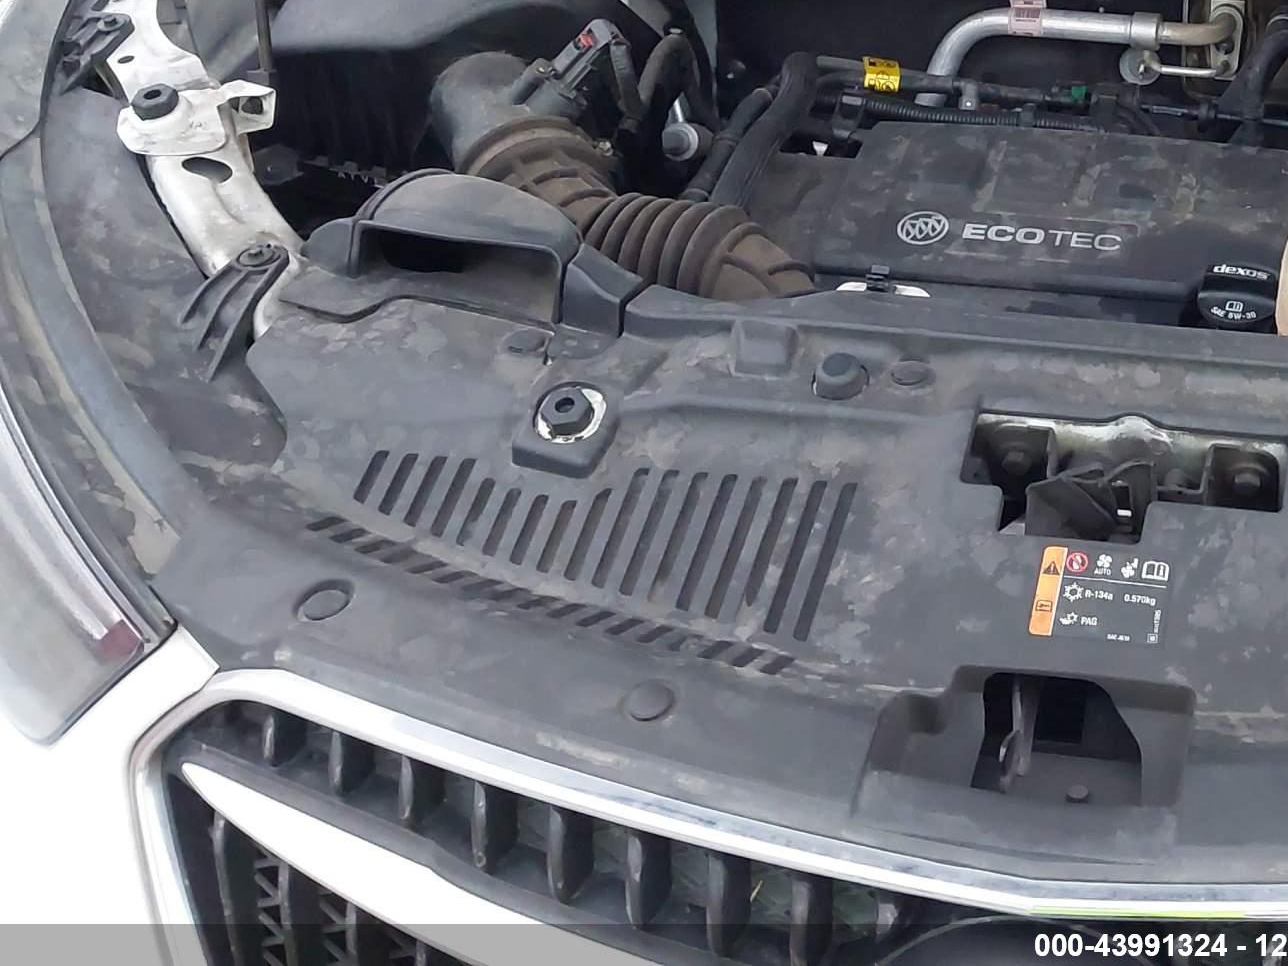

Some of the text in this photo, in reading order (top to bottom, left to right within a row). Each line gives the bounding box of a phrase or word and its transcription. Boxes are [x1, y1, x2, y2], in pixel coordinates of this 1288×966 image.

[962, 222, 1122, 251] ECOTEC
[1212, 263, 1269, 280] dexos
[1093, 567, 1112, 576] AUTO
[1084, 589, 1156, 607] R-134a 0.570kg
[1080, 616, 1098, 627] PAG
